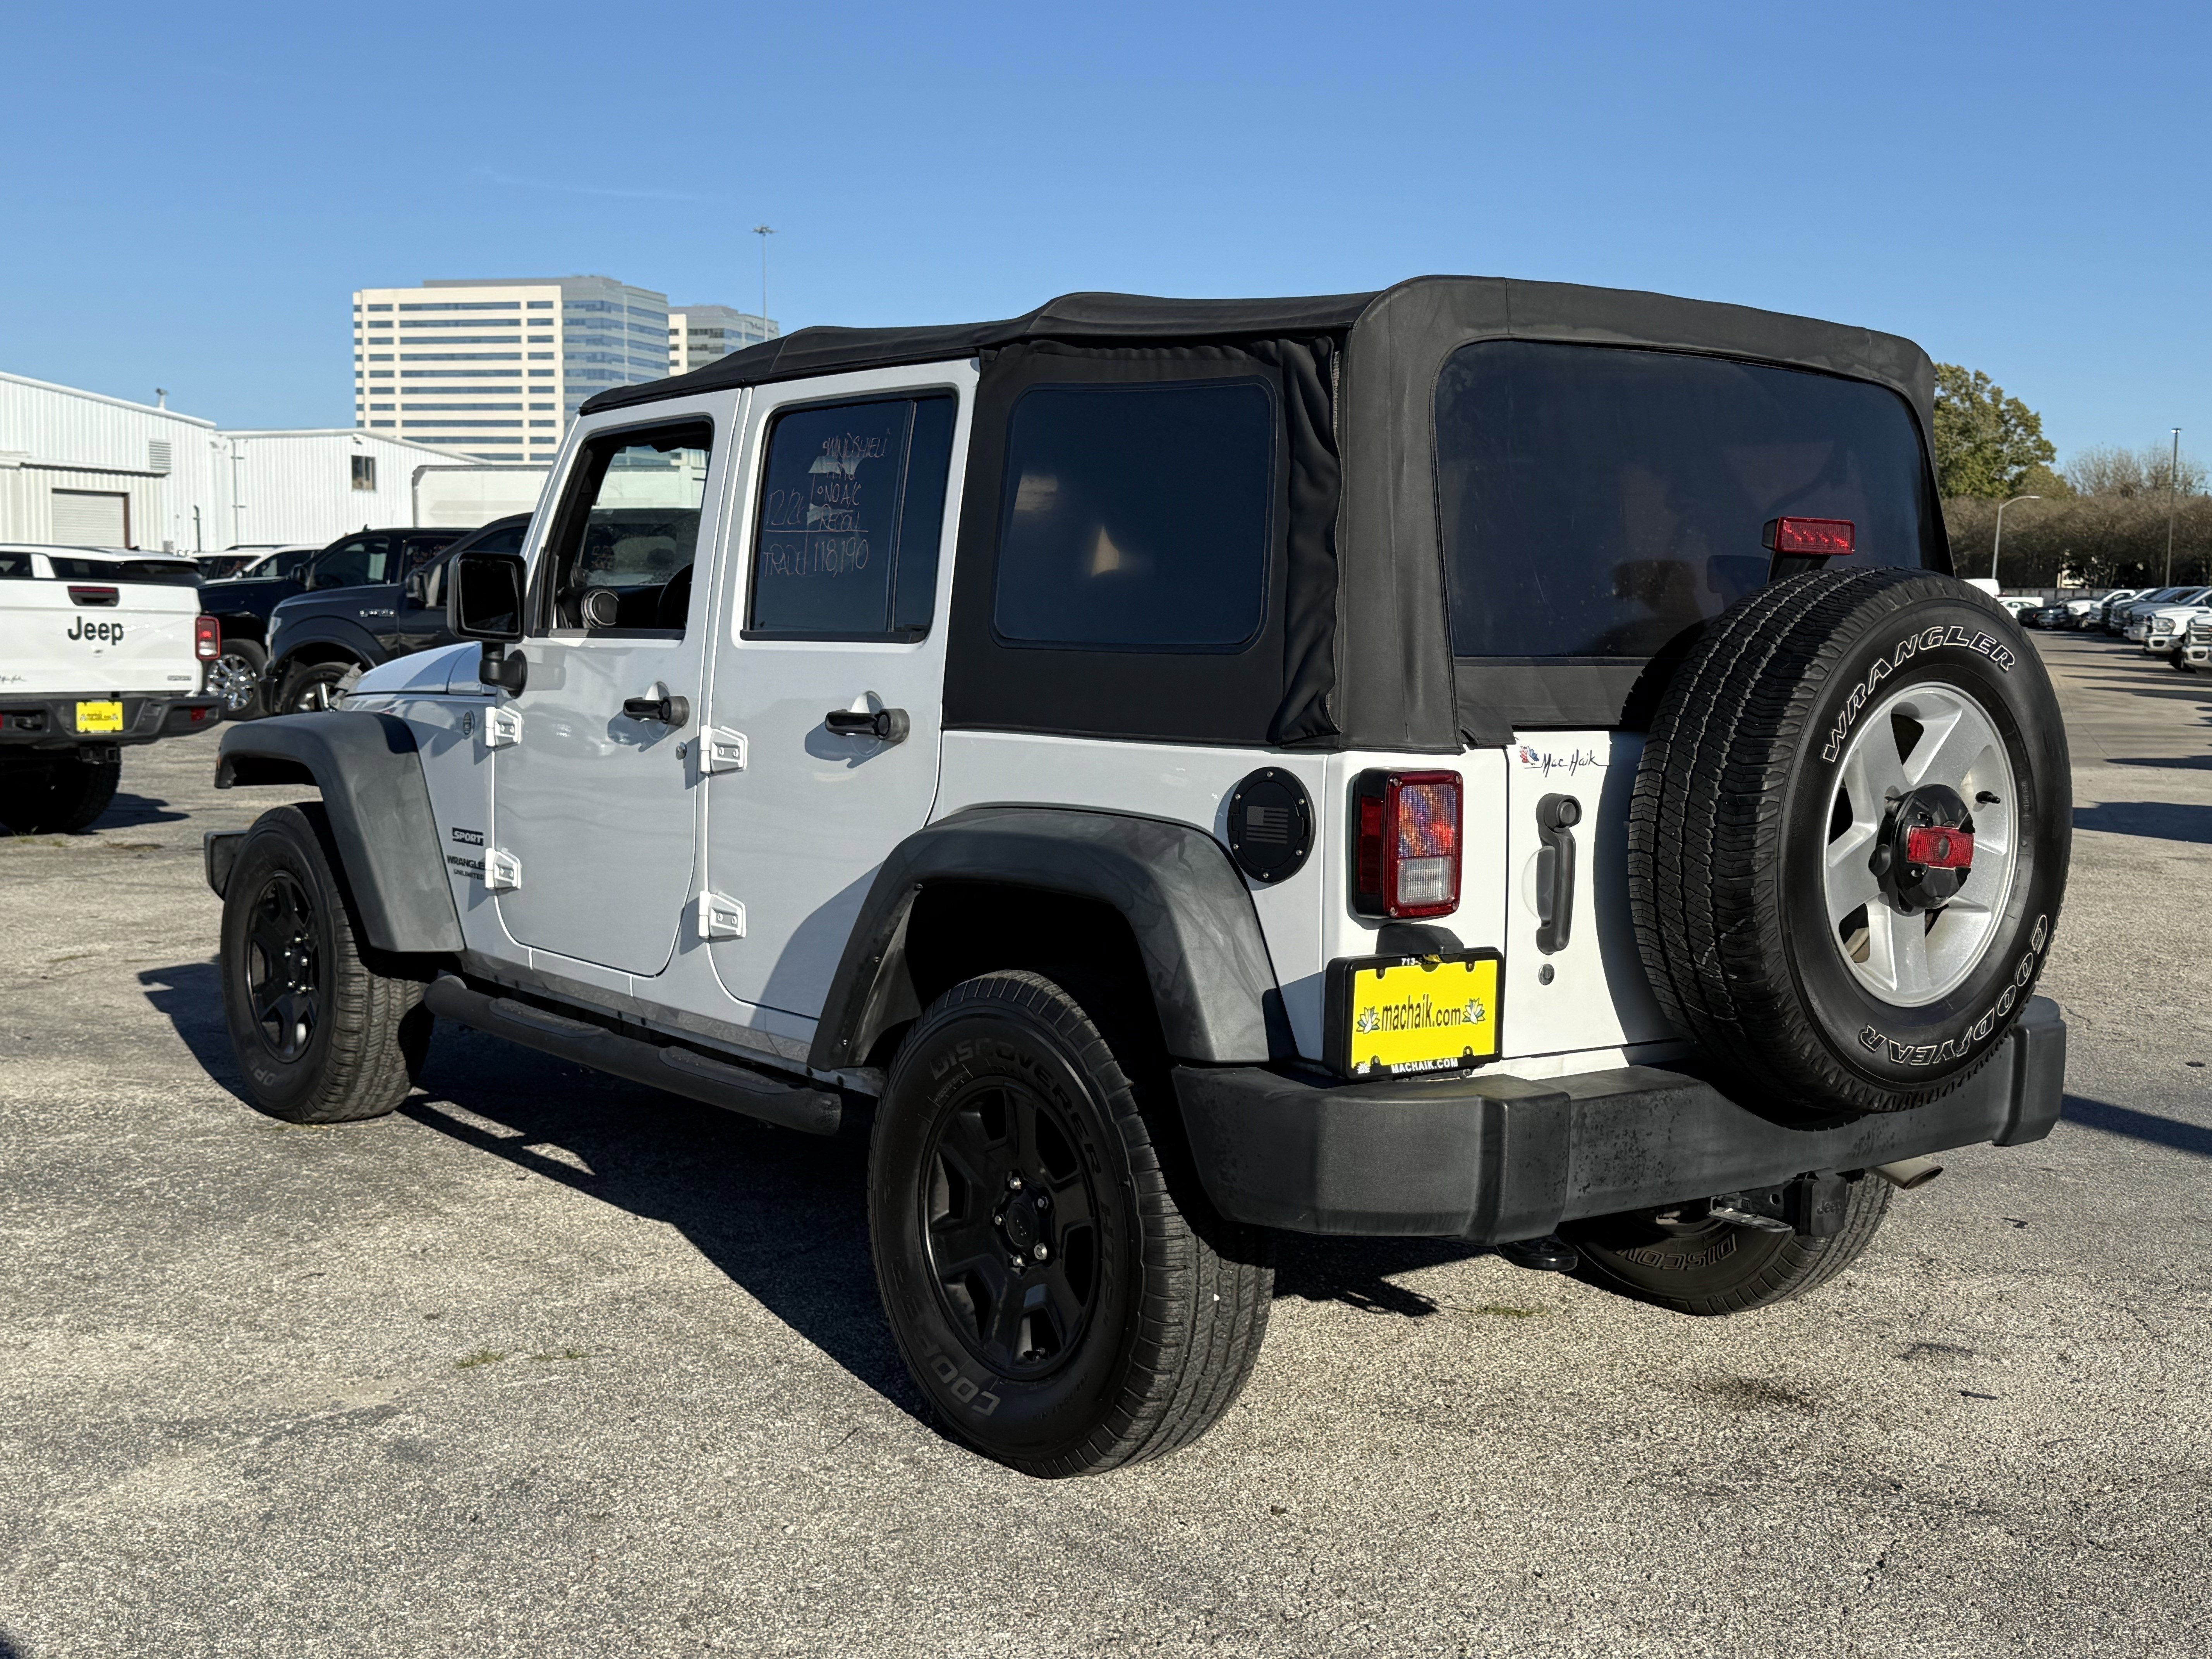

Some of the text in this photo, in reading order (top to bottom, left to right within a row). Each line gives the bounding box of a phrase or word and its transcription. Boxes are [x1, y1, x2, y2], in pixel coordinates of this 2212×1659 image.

[841, 482, 861, 508] A/C
[815, 537, 868, 577] 118,190
[67, 616, 124, 645] Jeep
[1821, 625, 2016, 763] WRANGLER
[1524, 749, 1613, 778] Mac Haik
[453, 831, 484, 843] SPORT
[1859, 914, 2048, 1066] GOODYEAR
[1381, 993, 1461, 1031] machaik.com
[1391, 1058, 1458, 1074] MACHAIK.COM
[929, 1037, 1102, 1175] DISCOVERER
[1817, 1199, 1843, 1215] Jeep
